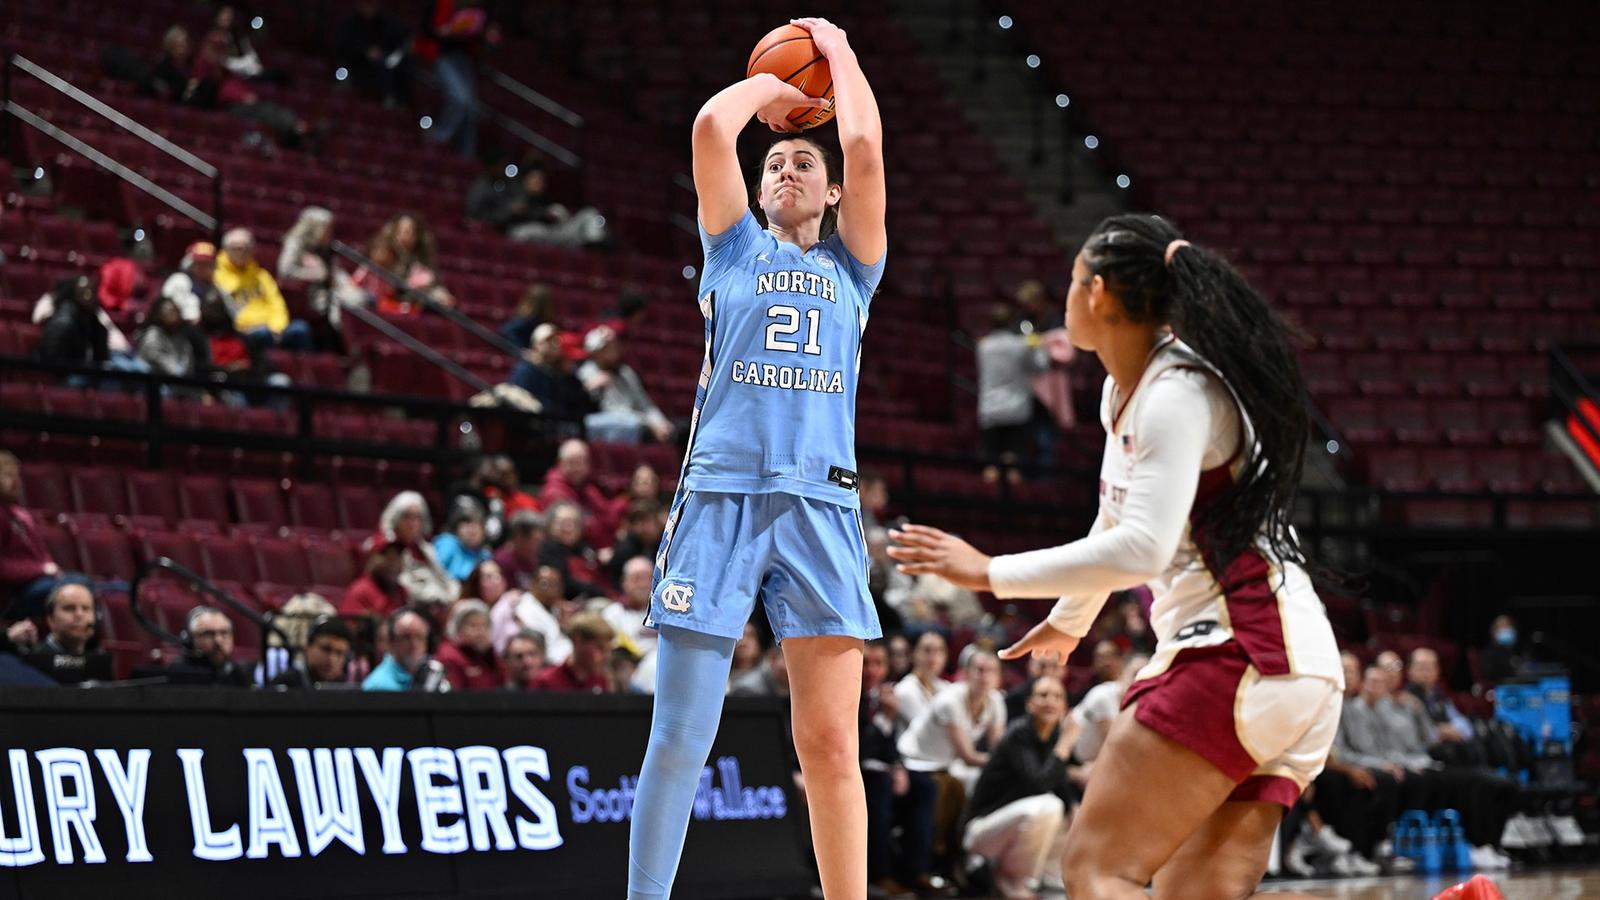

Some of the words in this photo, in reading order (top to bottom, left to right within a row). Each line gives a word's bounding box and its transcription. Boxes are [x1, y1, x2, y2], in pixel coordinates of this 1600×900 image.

[756, 270, 837, 303] NORTH
[764, 303, 822, 356] 21
[731, 359, 845, 393] CAROLINA
[176, 745, 564, 861] LAWYERS
